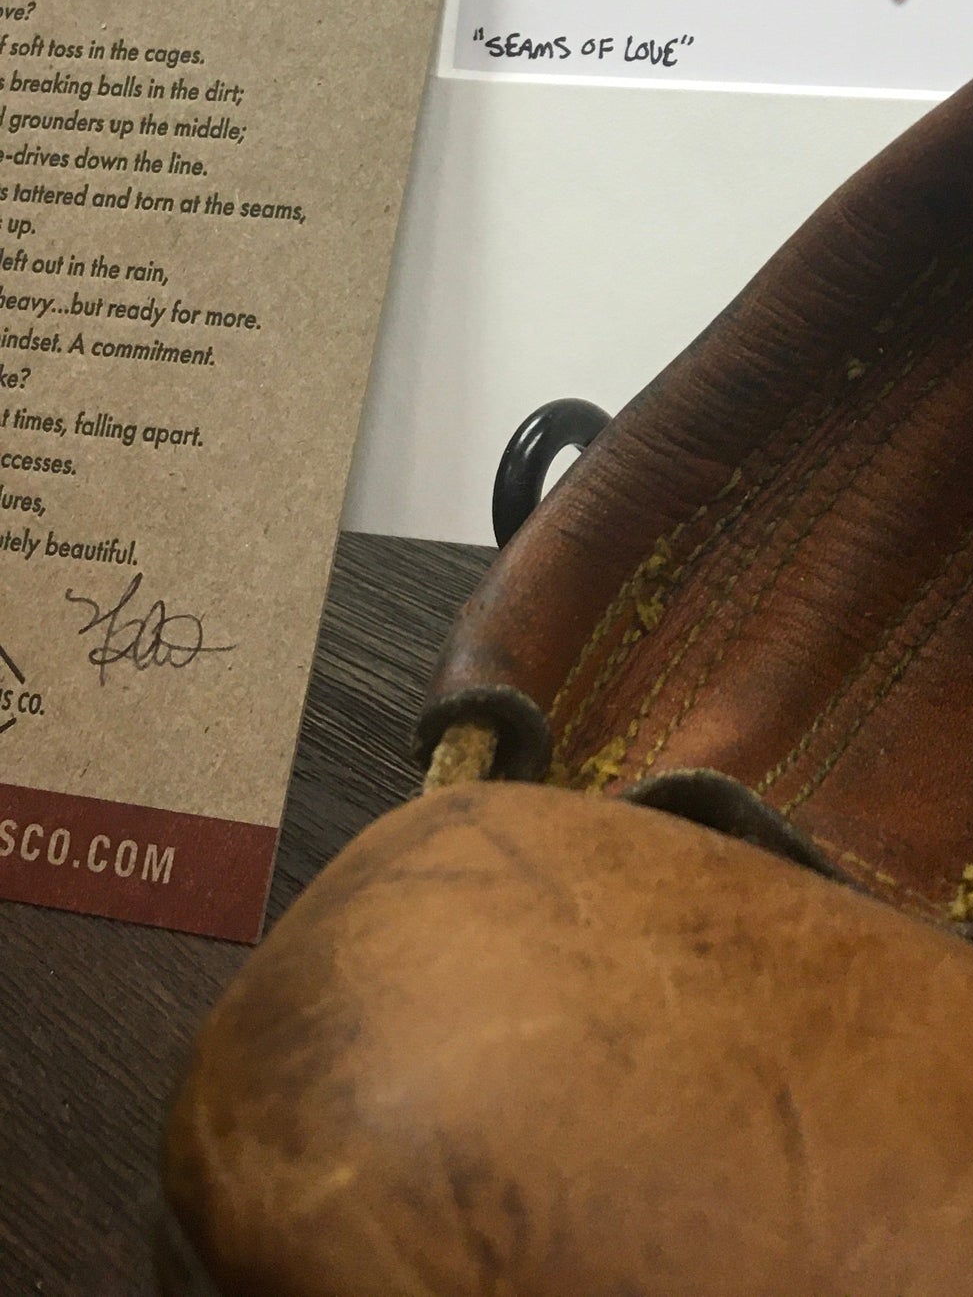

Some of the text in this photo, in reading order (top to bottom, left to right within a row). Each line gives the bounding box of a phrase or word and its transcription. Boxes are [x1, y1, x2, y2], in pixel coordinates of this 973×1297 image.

[9, 37, 44, 57] soft
[47, 38, 84, 59] toss
[88, 41, 105, 60] in
[109, 38, 139, 61] the
[144, 49, 205, 67] cages.
[580, 38, 614, 59] OF
[9, 70, 93, 100] breaking
[97, 74, 142, 98] balls
[147, 78, 166, 100] in
[171, 79, 200, 101] the
[205, 79, 245, 105] dirt;
[8, 108, 105, 133] grounders
[109, 118, 134, 139] up
[139, 115, 169, 137] the
[173, 116, 248, 142] middle;
[74, 146, 129, 171] down
[133, 151, 163, 174] the
[168, 152, 208, 176] line.
[0, 184, 306, 224] s tattered and torn at the seams,
[7, 215, 37, 238] up.
[31, 257, 63, 278] out
[67, 257, 86, 279] in
[90, 256, 121, 281] the
[124, 261, 170, 286] rain,
[106, 295, 166, 326] ready
[170, 302, 201, 325] for
[204, 307, 262, 331] more.
[0, 329, 216, 367] indset. A commitment.
[0, 409, 204, 449] t times, falling apart.
[45, 531, 139, 566] beautiful.
[0, 688, 44, 715] S CO.
